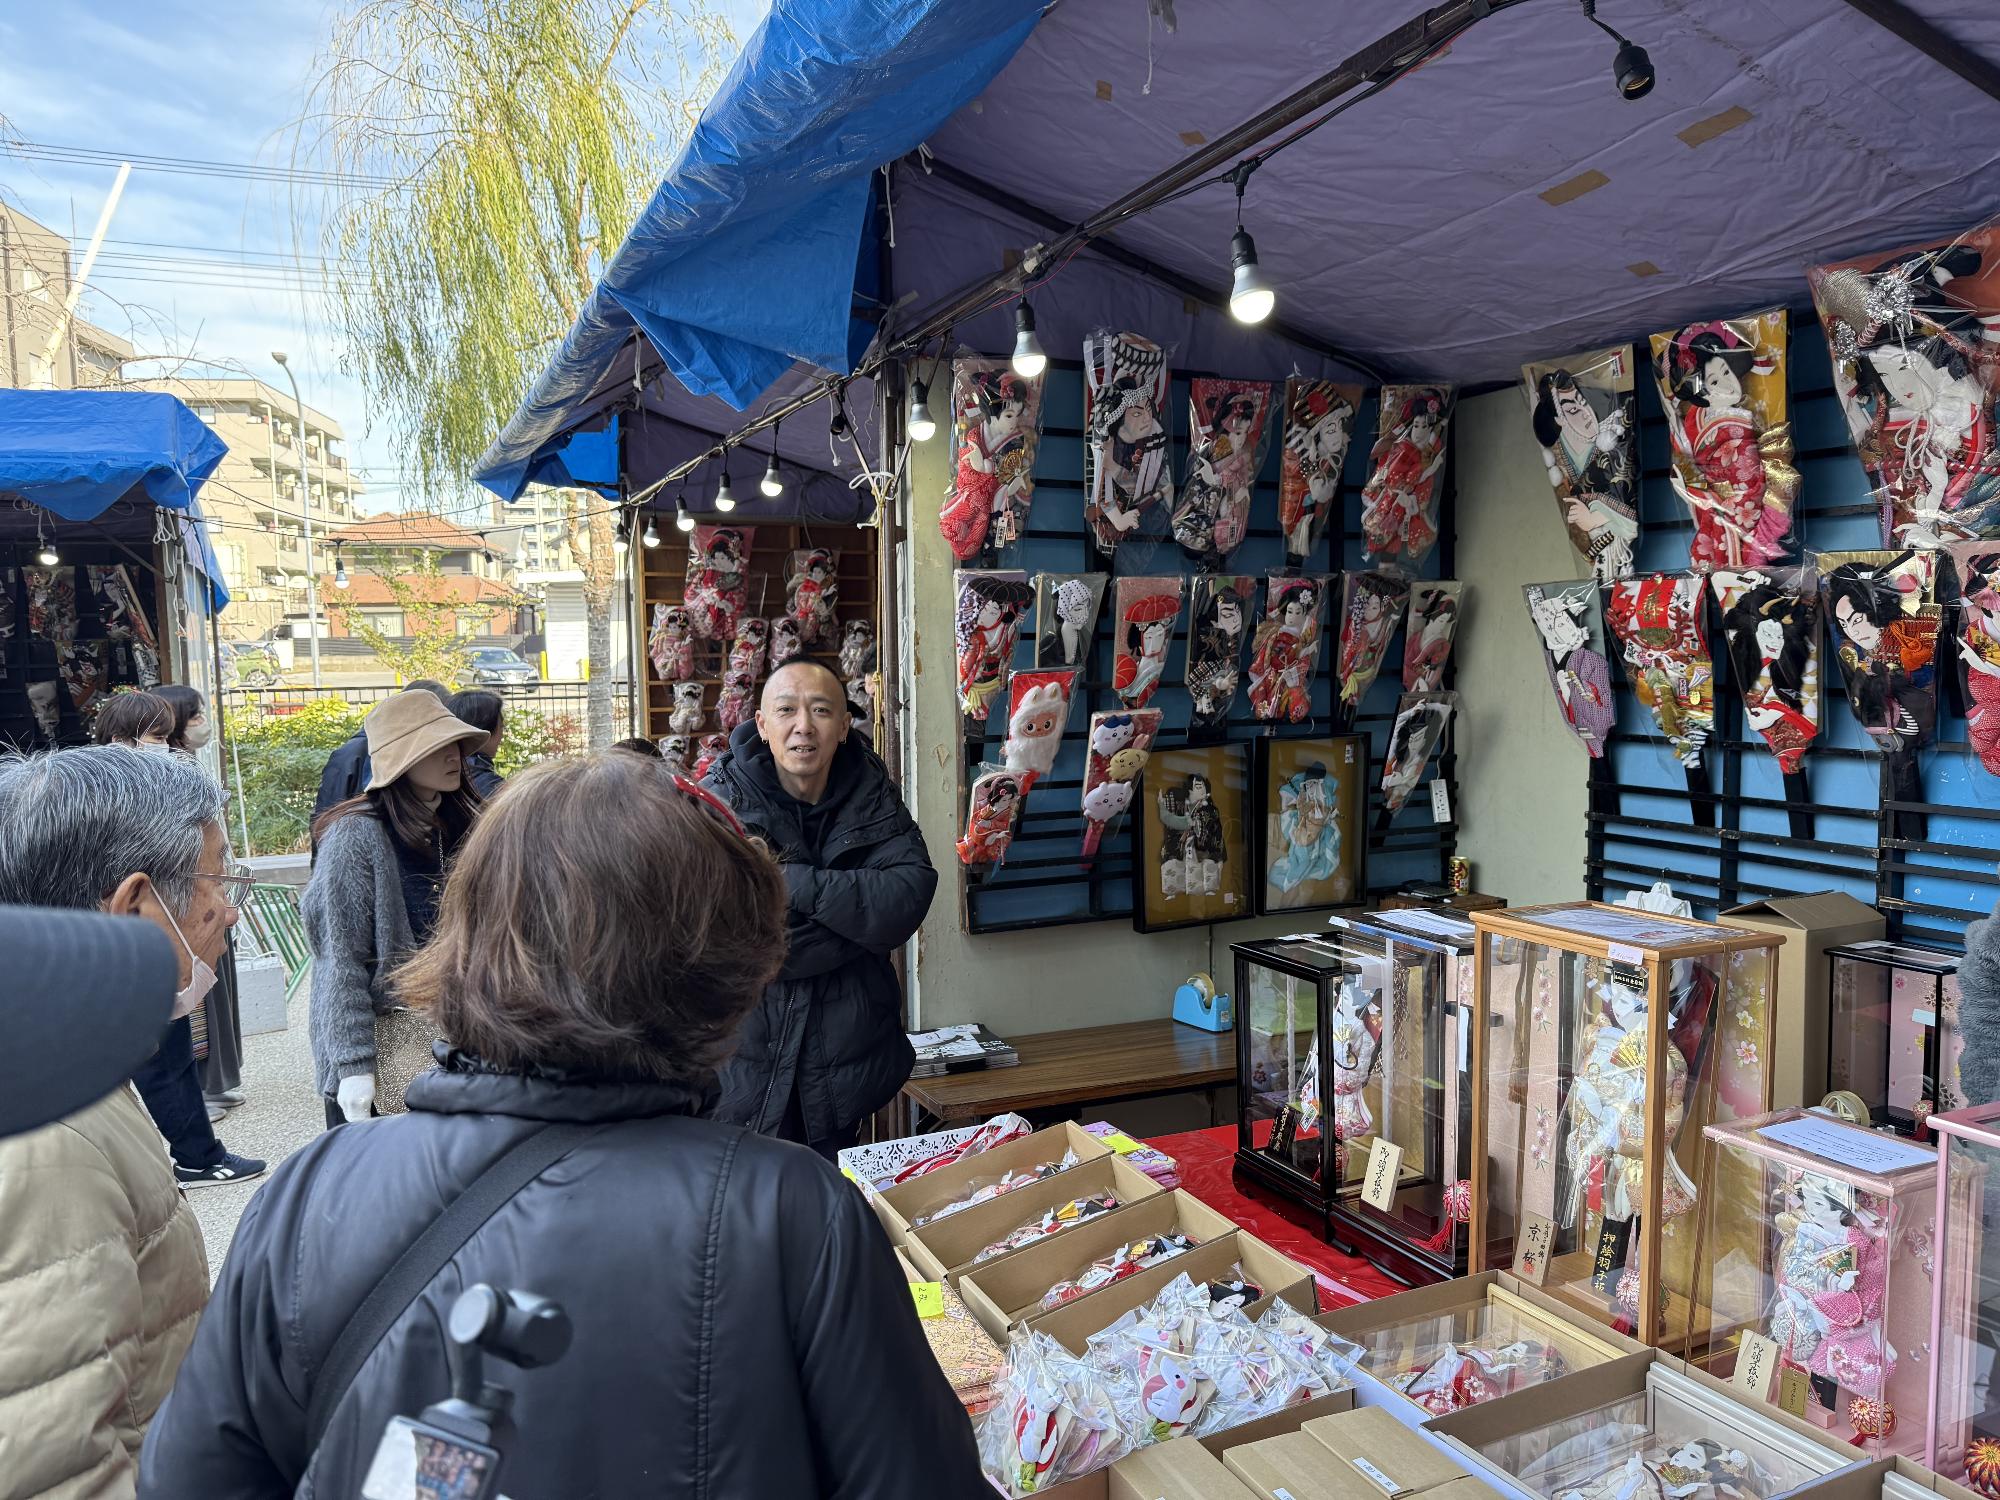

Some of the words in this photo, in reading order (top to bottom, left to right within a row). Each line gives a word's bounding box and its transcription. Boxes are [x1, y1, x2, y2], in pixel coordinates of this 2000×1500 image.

[1594, 1231, 1617, 1291] 押絵羽子板
